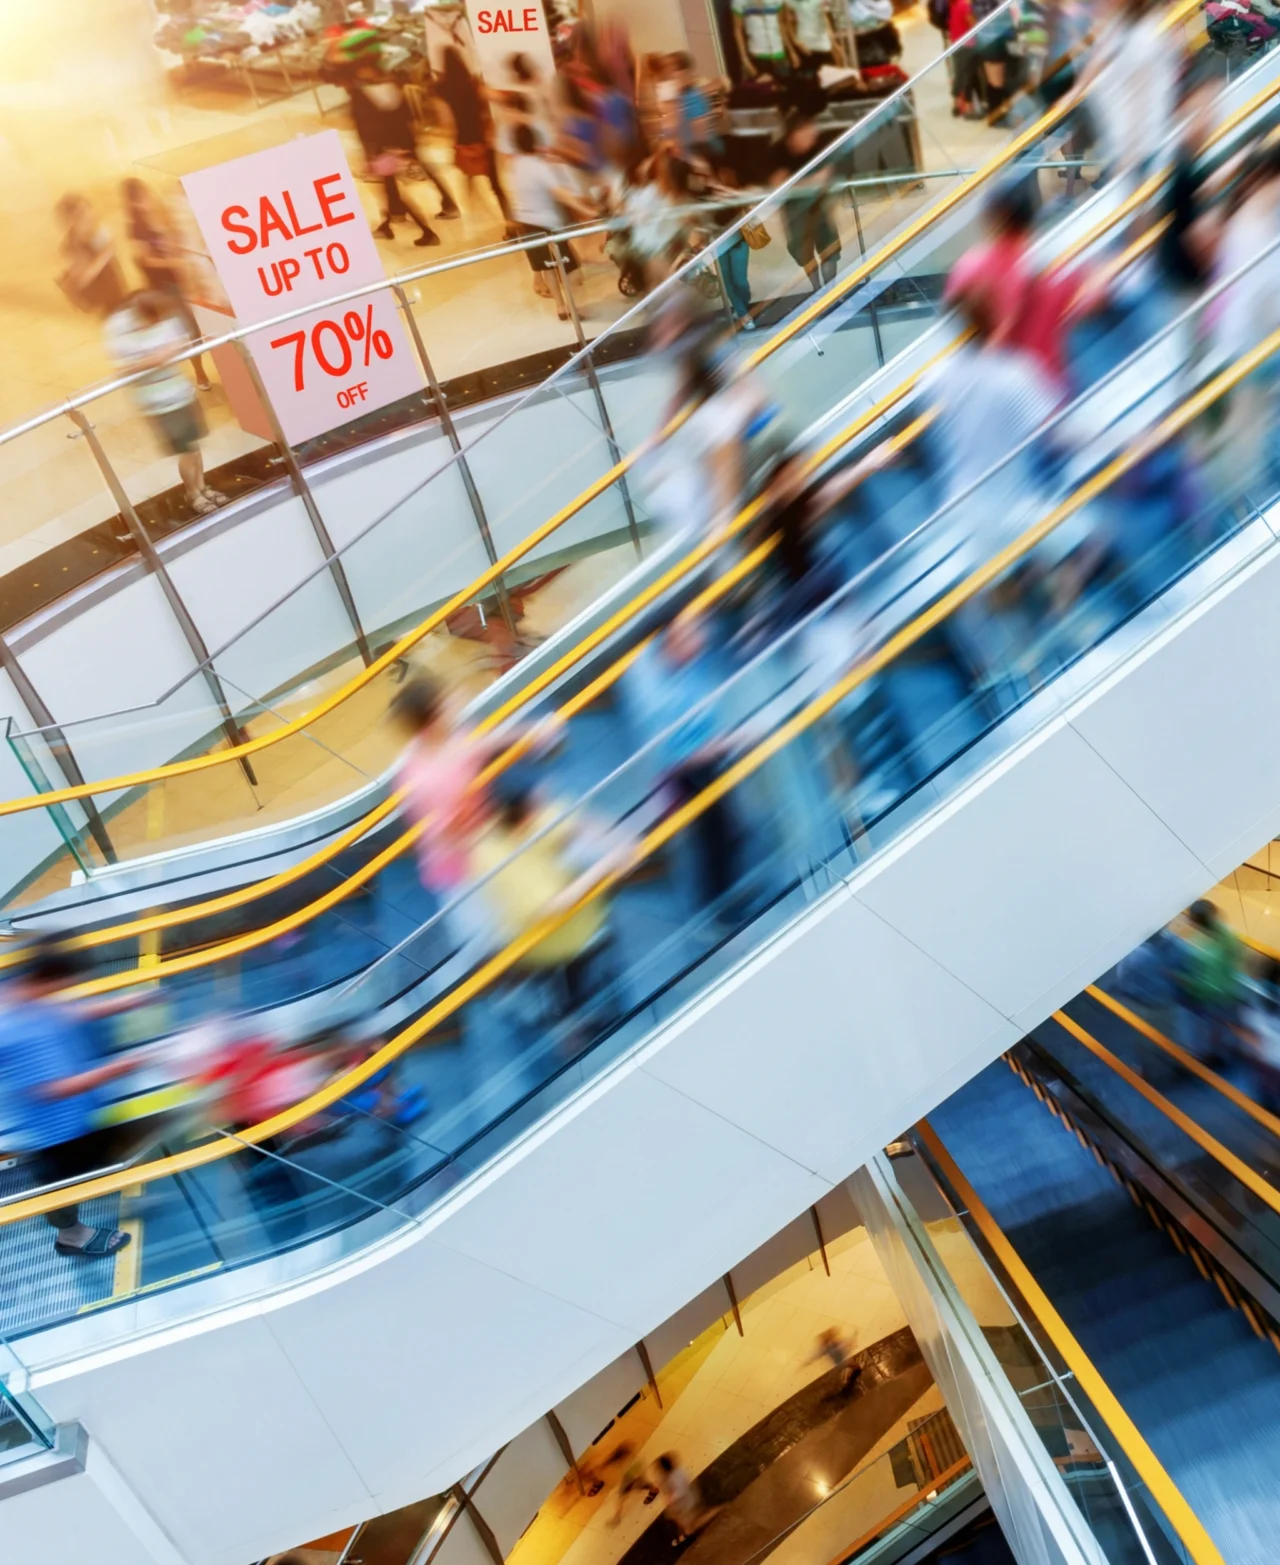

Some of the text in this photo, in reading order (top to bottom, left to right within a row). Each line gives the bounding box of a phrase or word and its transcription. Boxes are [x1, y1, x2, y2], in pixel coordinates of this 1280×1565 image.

[477, 8, 539, 34] SALE
[220, 172, 356, 255] SALE
[257, 242, 350, 297] UP TO
[270, 303, 394, 393] 70%
[336, 381, 369, 409] OFF
